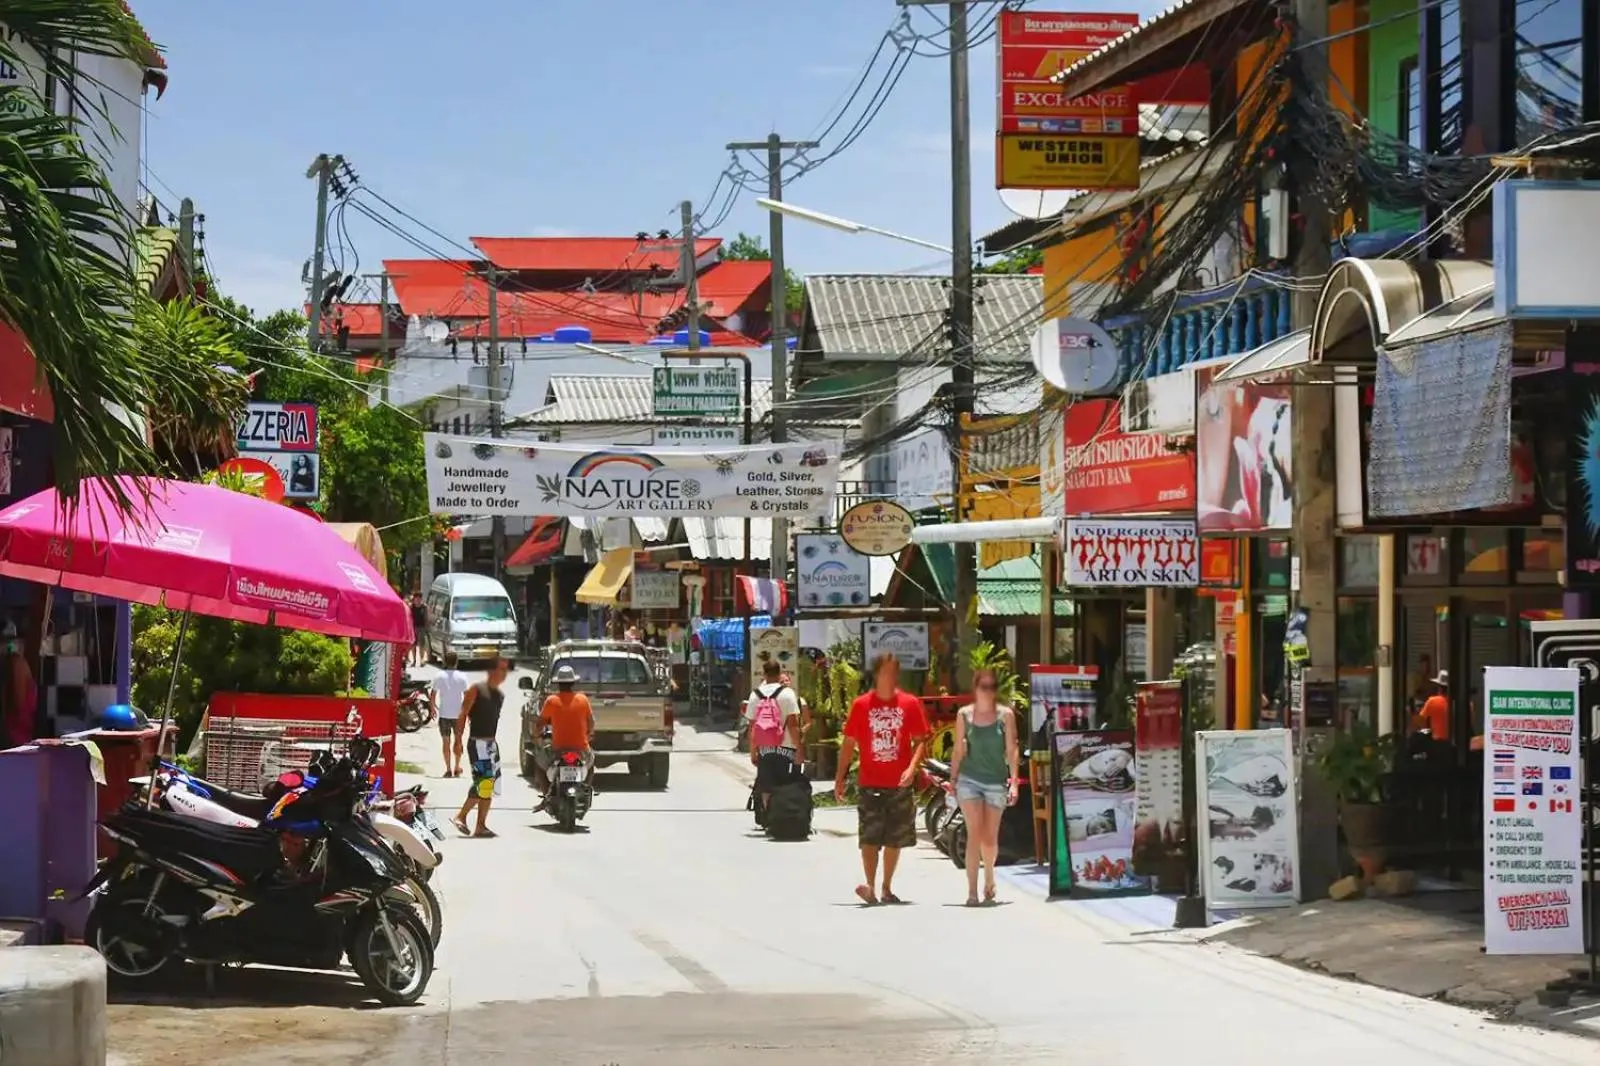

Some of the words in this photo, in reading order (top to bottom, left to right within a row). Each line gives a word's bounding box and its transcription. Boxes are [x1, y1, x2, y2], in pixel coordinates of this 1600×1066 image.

[1013, 92, 1129, 107] EXCHANGE
[1018, 140, 1103, 152] WESTERN
[1045, 153, 1103, 164] UNION
[444, 467, 509, 478] Handmade
[747, 472, 776, 483] Gold,
[779, 471, 815, 483] Silver,
[1086, 469, 1107, 488] CITY
[1108, 466, 1132, 485] BANK
[447, 482, 506, 495] Jewellery
[566, 479, 680, 498] NATURE
[736, 486, 782, 498] Leather,
[785, 487, 824, 497] Stones
[436, 497, 467, 508] Made
[471, 497, 482, 508] to
[486, 497, 520, 509] Order
[616, 500, 644, 510] ART
[650, 500, 714, 511] GALLERY
[750, 501, 759, 511] &
[761, 500, 809, 512] Crystals
[850, 514, 905, 525] FUSION
[1074, 527, 1194, 538] UNDERGROUND
[1071, 536, 1196, 570] TATTOO
[1085, 569, 1119, 582] ART
[1124, 569, 1148, 582] ON
[1508, 697, 1552, 709] INTERNATIONAL
[1553, 697, 1571, 710] CLINIC
[1505, 832, 1517, 841] CALL
[1499, 895, 1547, 909] EMERGENCY
